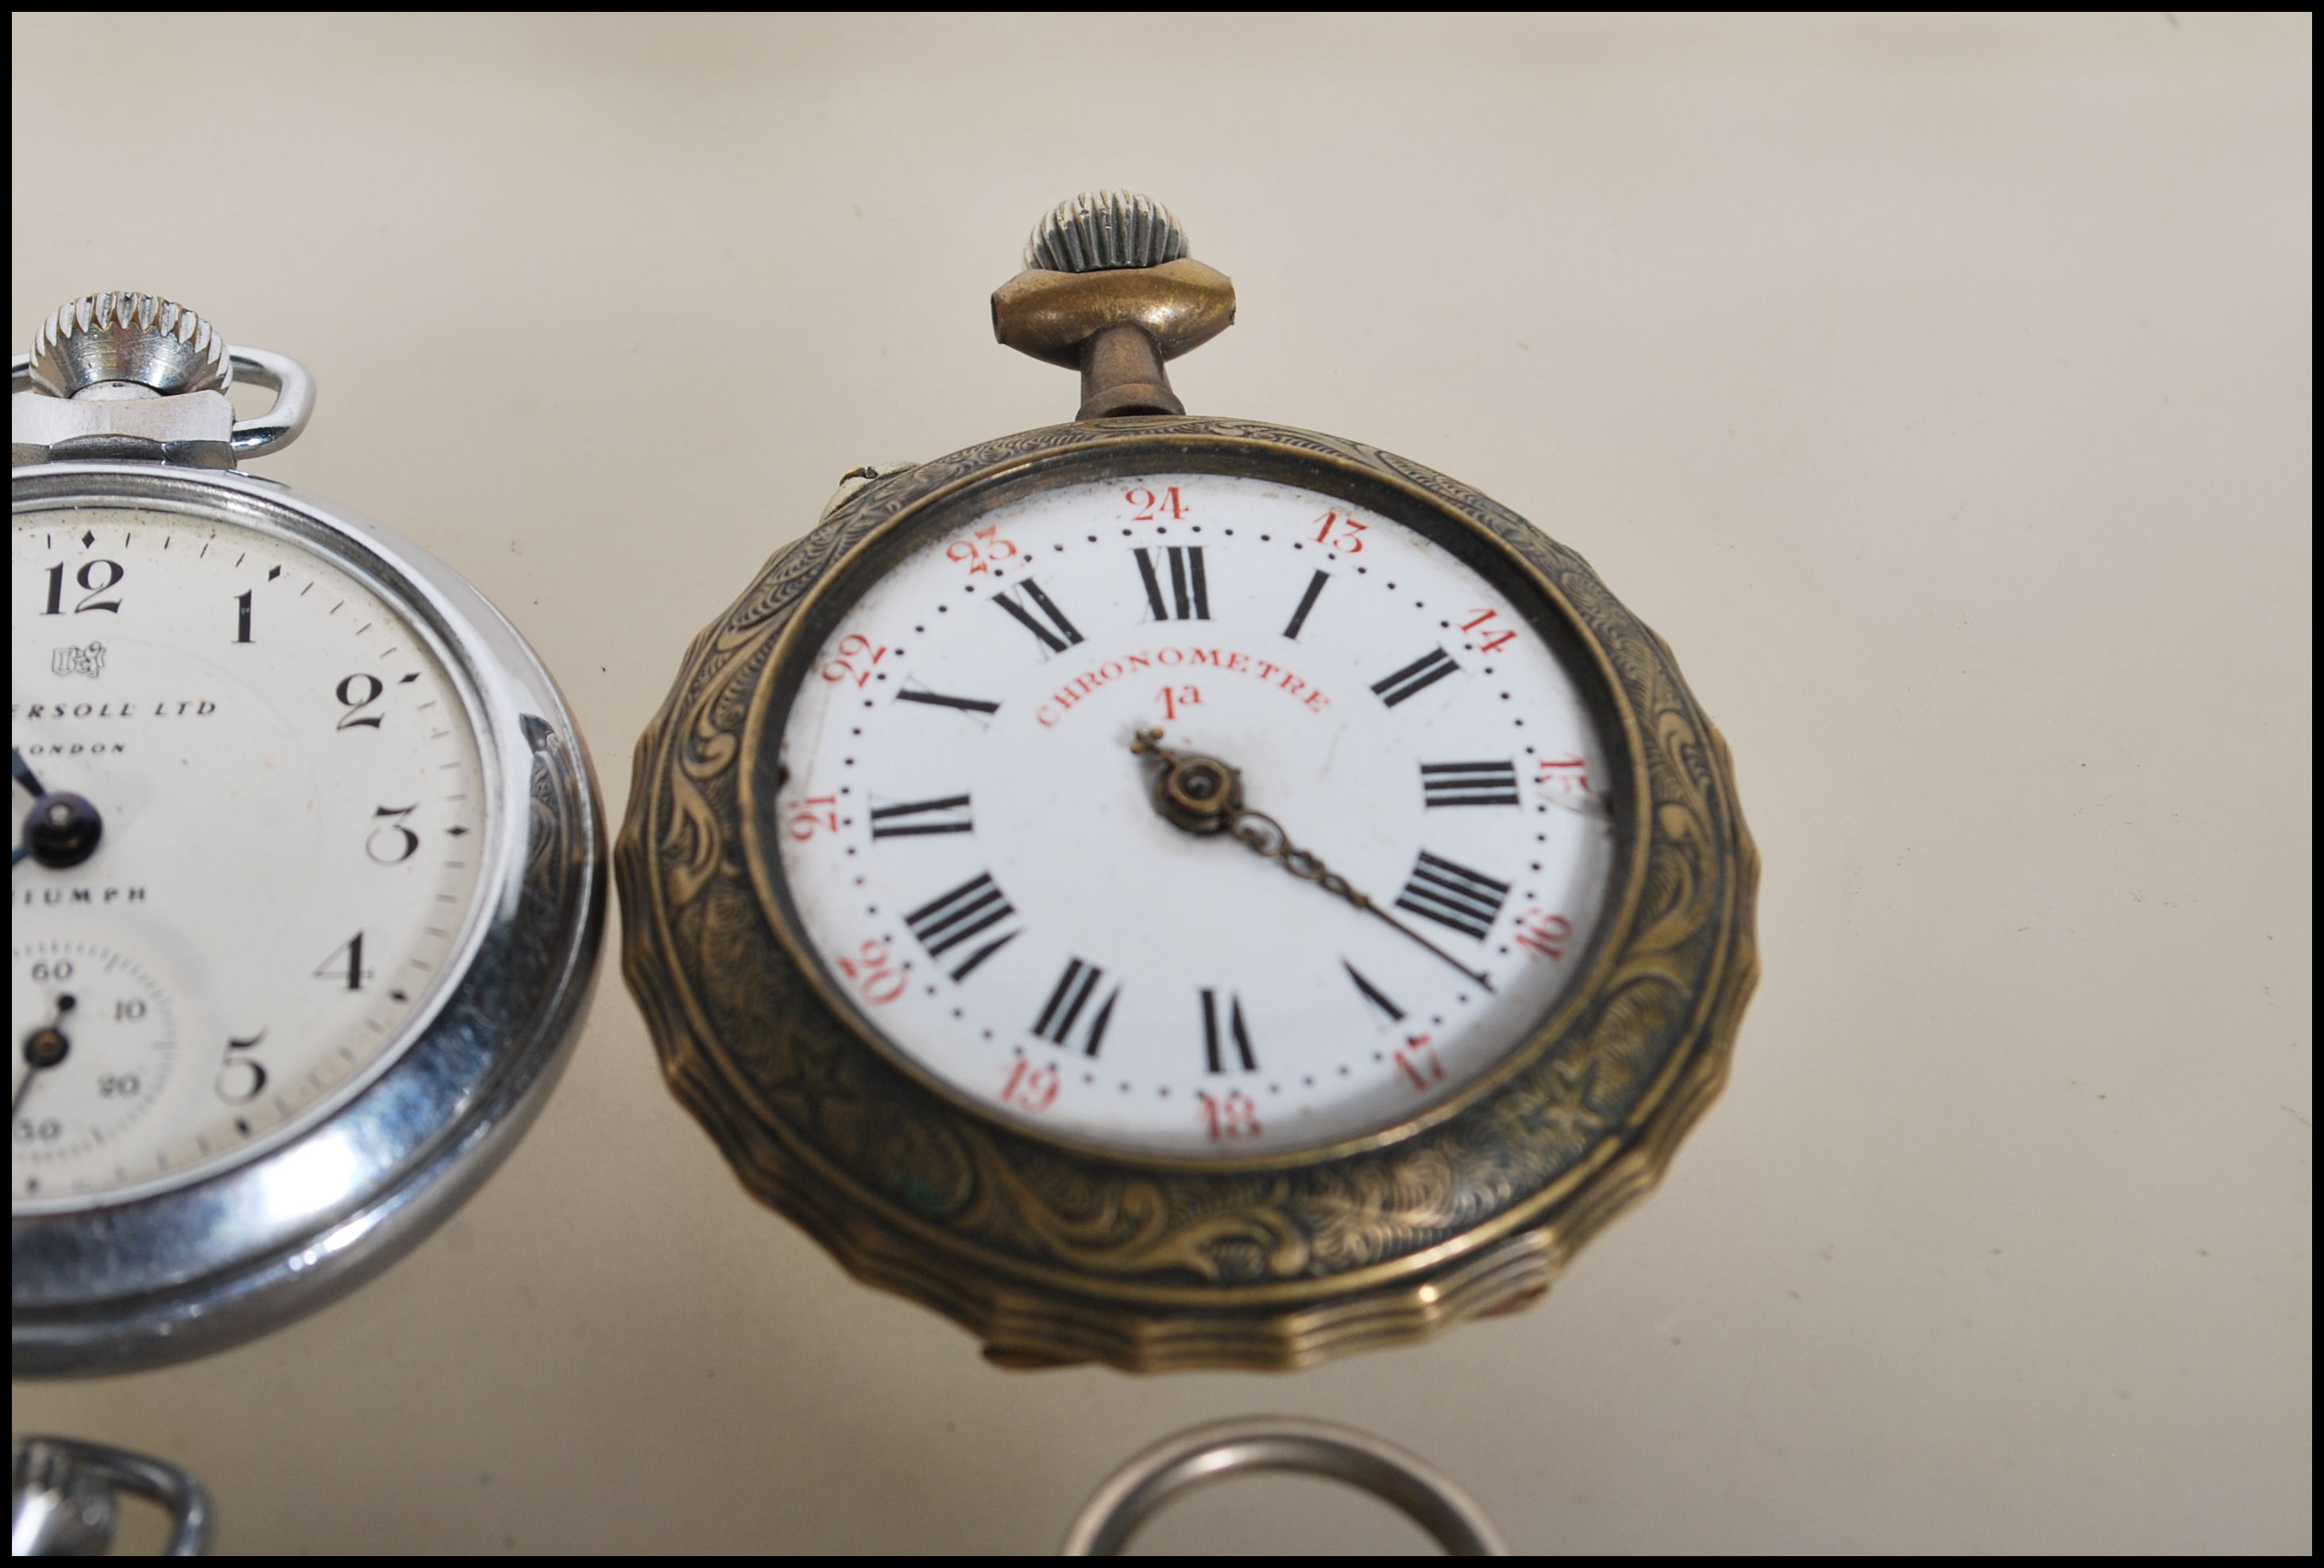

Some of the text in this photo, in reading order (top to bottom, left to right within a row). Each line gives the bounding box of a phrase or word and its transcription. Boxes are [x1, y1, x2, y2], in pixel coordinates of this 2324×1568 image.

[1125, 485, 1191, 522] 24
[1314, 509, 1369, 554] 13
[946, 524, 1017, 574] 23
[39, 559, 125, 616] 12
[1131, 545, 1214, 622] XII
[1281, 569, 1331, 641] I
[231, 589, 255, 644] 1
[990, 577, 1087, 661] XI
[1460, 608, 1519, 654] 14
[821, 633, 887, 688] 22
[1036, 647, 1331, 728] CHRONOMETRE
[1369, 645, 1462, 709] II
[154, 701, 216, 716] LTD
[335, 674, 384, 732] 2
[12, 743, 125, 756] ONDON
[1539, 756, 1590, 792] 15
[1419, 760, 1521, 809] III
[365, 803, 420, 863] 3
[787, 794, 840, 843] 21
[869, 793, 975, 842] IX
[12, 886, 146, 906] IUMPH
[1396, 851, 1511, 941] IIII
[902, 871, 1026, 983] VIII
[1515, 908, 1573, 964] 16
[31, 960, 75, 982] 60
[312, 929, 375, 991] 4
[836, 940, 908, 1006] 20
[114, 1000, 148, 1022] 10
[1029, 956, 1123, 1059] VII
[1199, 987, 1259, 1076] VI
[98, 1075, 141, 1099] 20
[214, 1027, 267, 1106] 5
[998, 1057, 1060, 1113] 19
[1392, 1033, 1448, 1093] 17
[1202, 1095, 1262, 1145] 18
